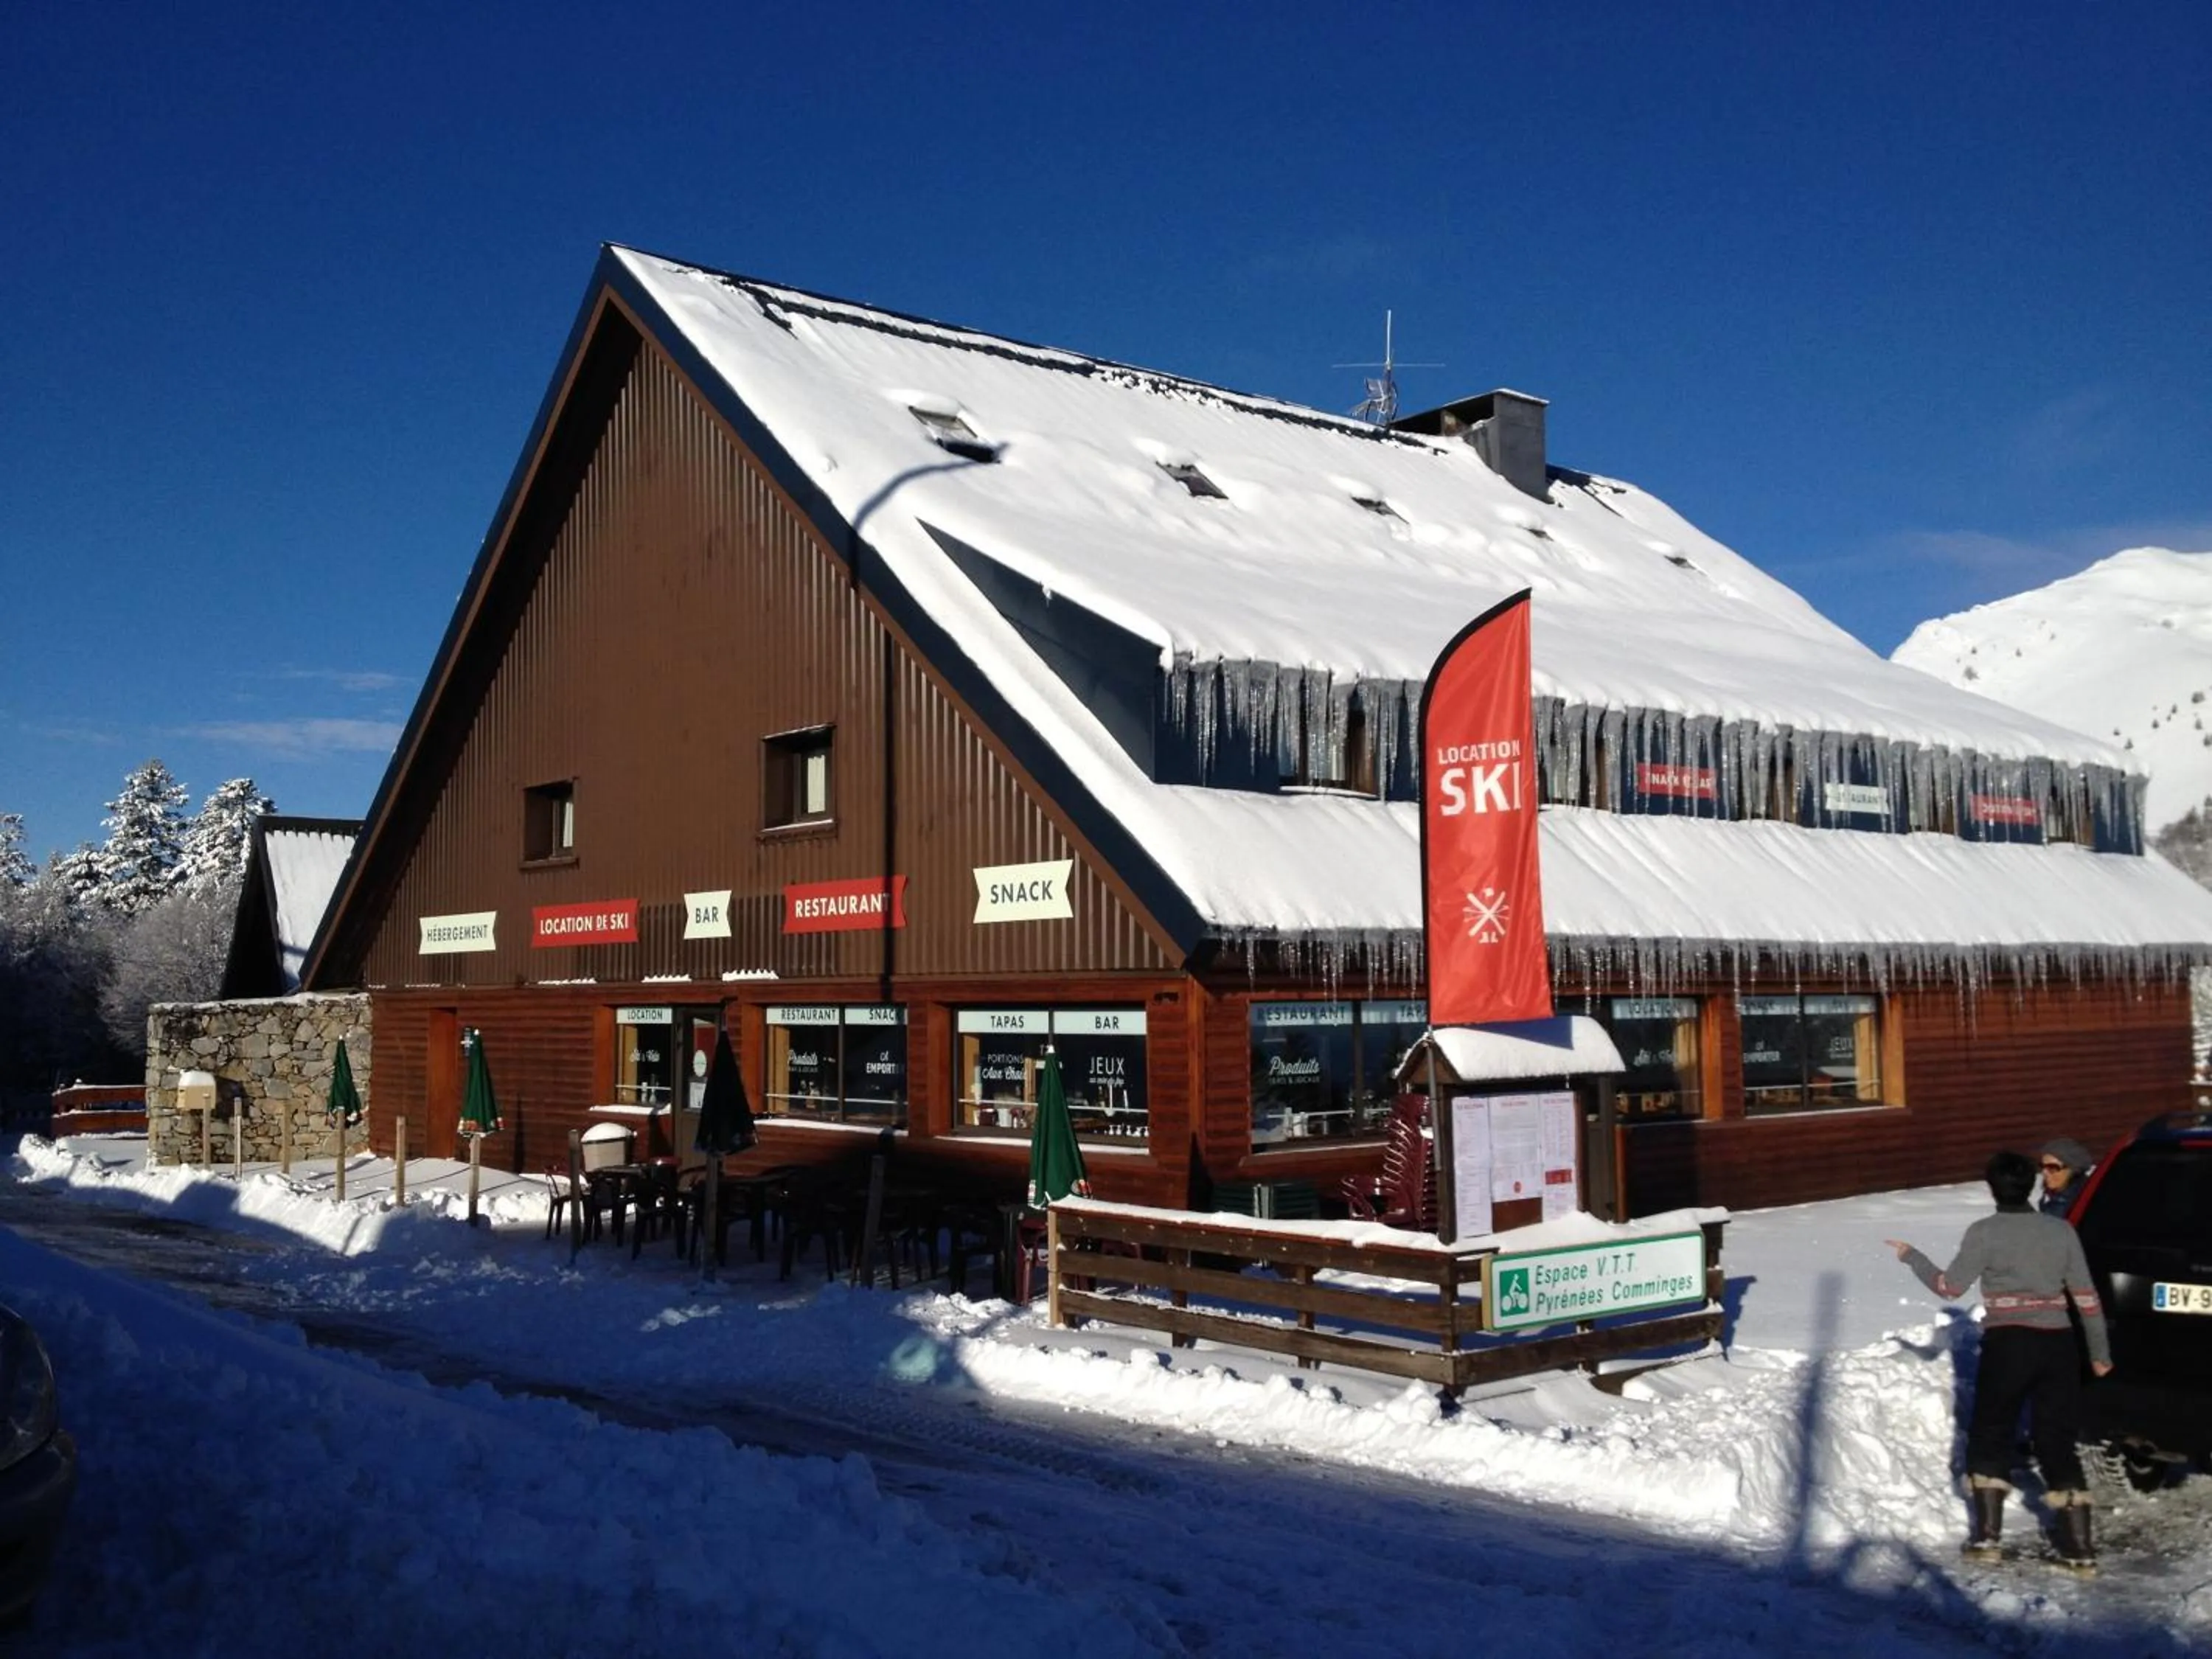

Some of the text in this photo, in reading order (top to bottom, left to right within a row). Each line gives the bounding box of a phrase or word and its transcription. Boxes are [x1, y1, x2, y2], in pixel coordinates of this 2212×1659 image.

[1438, 740, 1520, 765] LOCATION
[1440, 761, 1522, 816] SKI
[1645, 773, 1680, 786] NACK
[990, 880, 1054, 904] SNACK
[795, 892, 891, 918] RESTAURANT
[540, 911, 630, 936] LOCATION DE SKI
[695, 906, 720, 925] BAR
[427, 922, 488, 943] HÉBERGEMENT
[627, 1009, 663, 1020] LOCATION
[781, 1009, 837, 1020] RESTAURANT
[1256, 1006, 1346, 1021] RESTAURANT
[1399, 1004, 1428, 1018] TAP
[991, 1015, 1025, 1029] TAPAS
[1095, 1016, 1120, 1030] BAR
[1088, 1056, 1125, 1076] JEUX
[1268, 1055, 1321, 1076] Produits
[1535, 1262, 1588, 1289] Espace
[1536, 1273, 1694, 1316] Pyrénées Comminges
